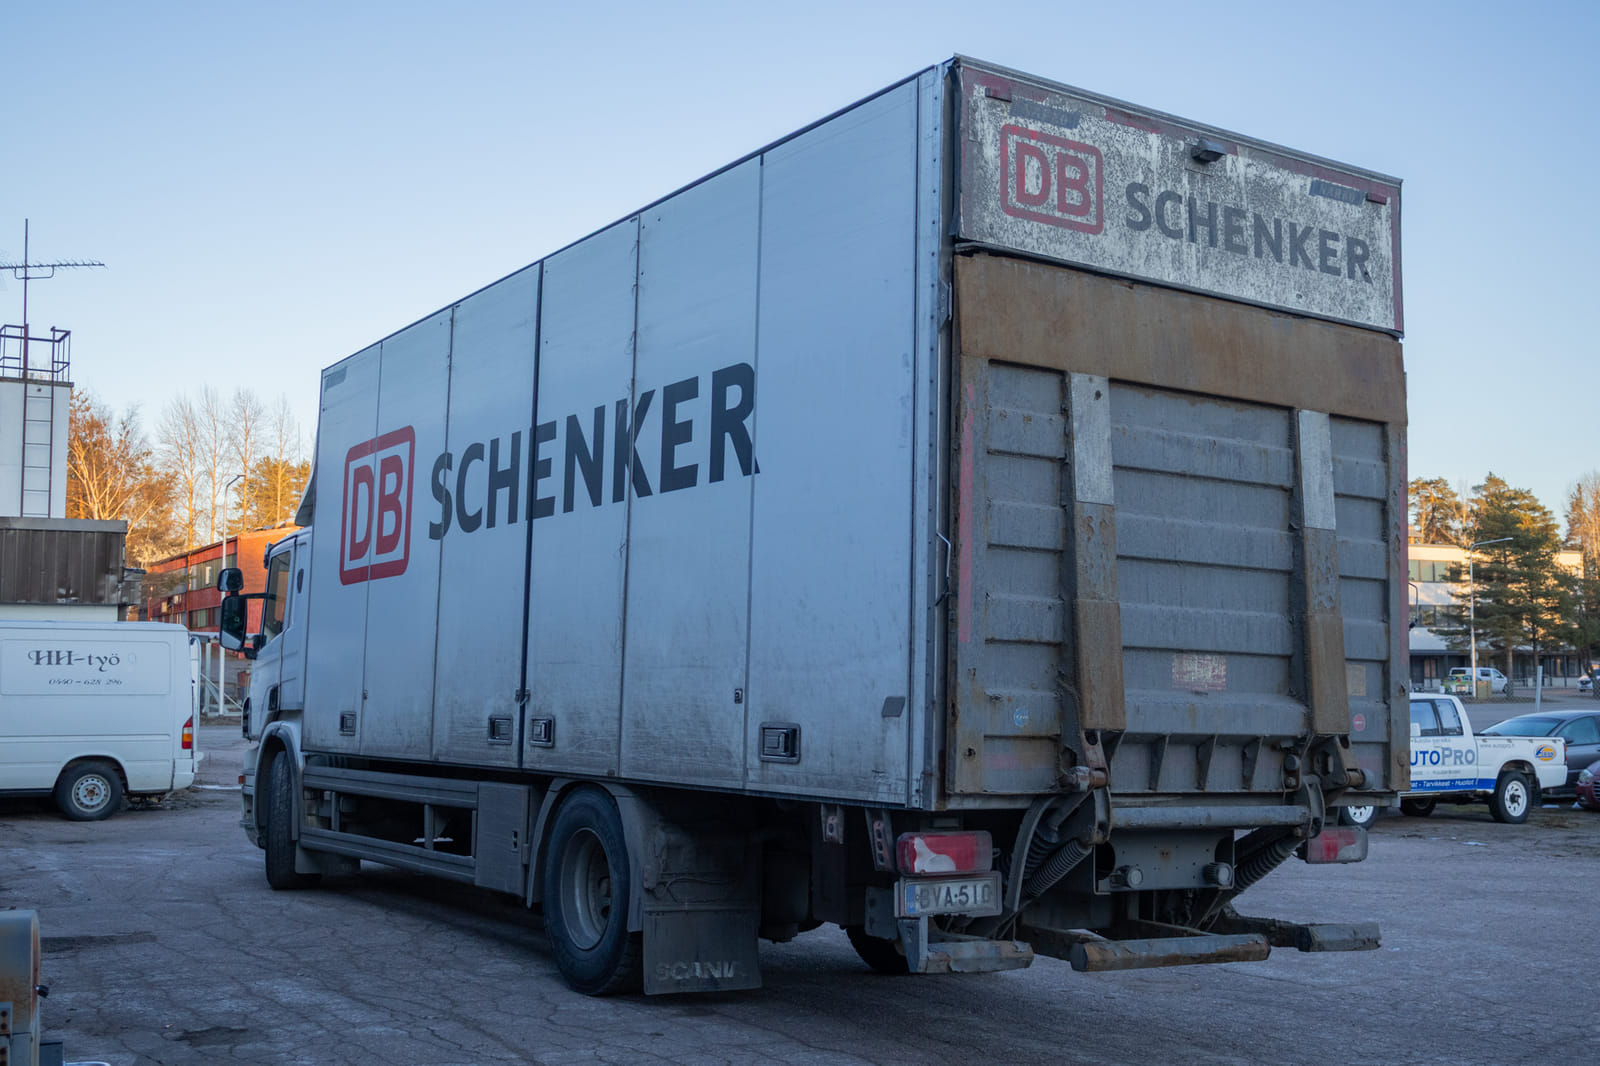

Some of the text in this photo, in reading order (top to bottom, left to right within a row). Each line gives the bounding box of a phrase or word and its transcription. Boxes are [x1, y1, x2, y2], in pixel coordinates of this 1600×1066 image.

[1013, 139, 1372, 284] DB SCHENKER
[346, 362, 760, 565] DB SCHENKER
[1410, 747, 1476, 766] UTOPRO
